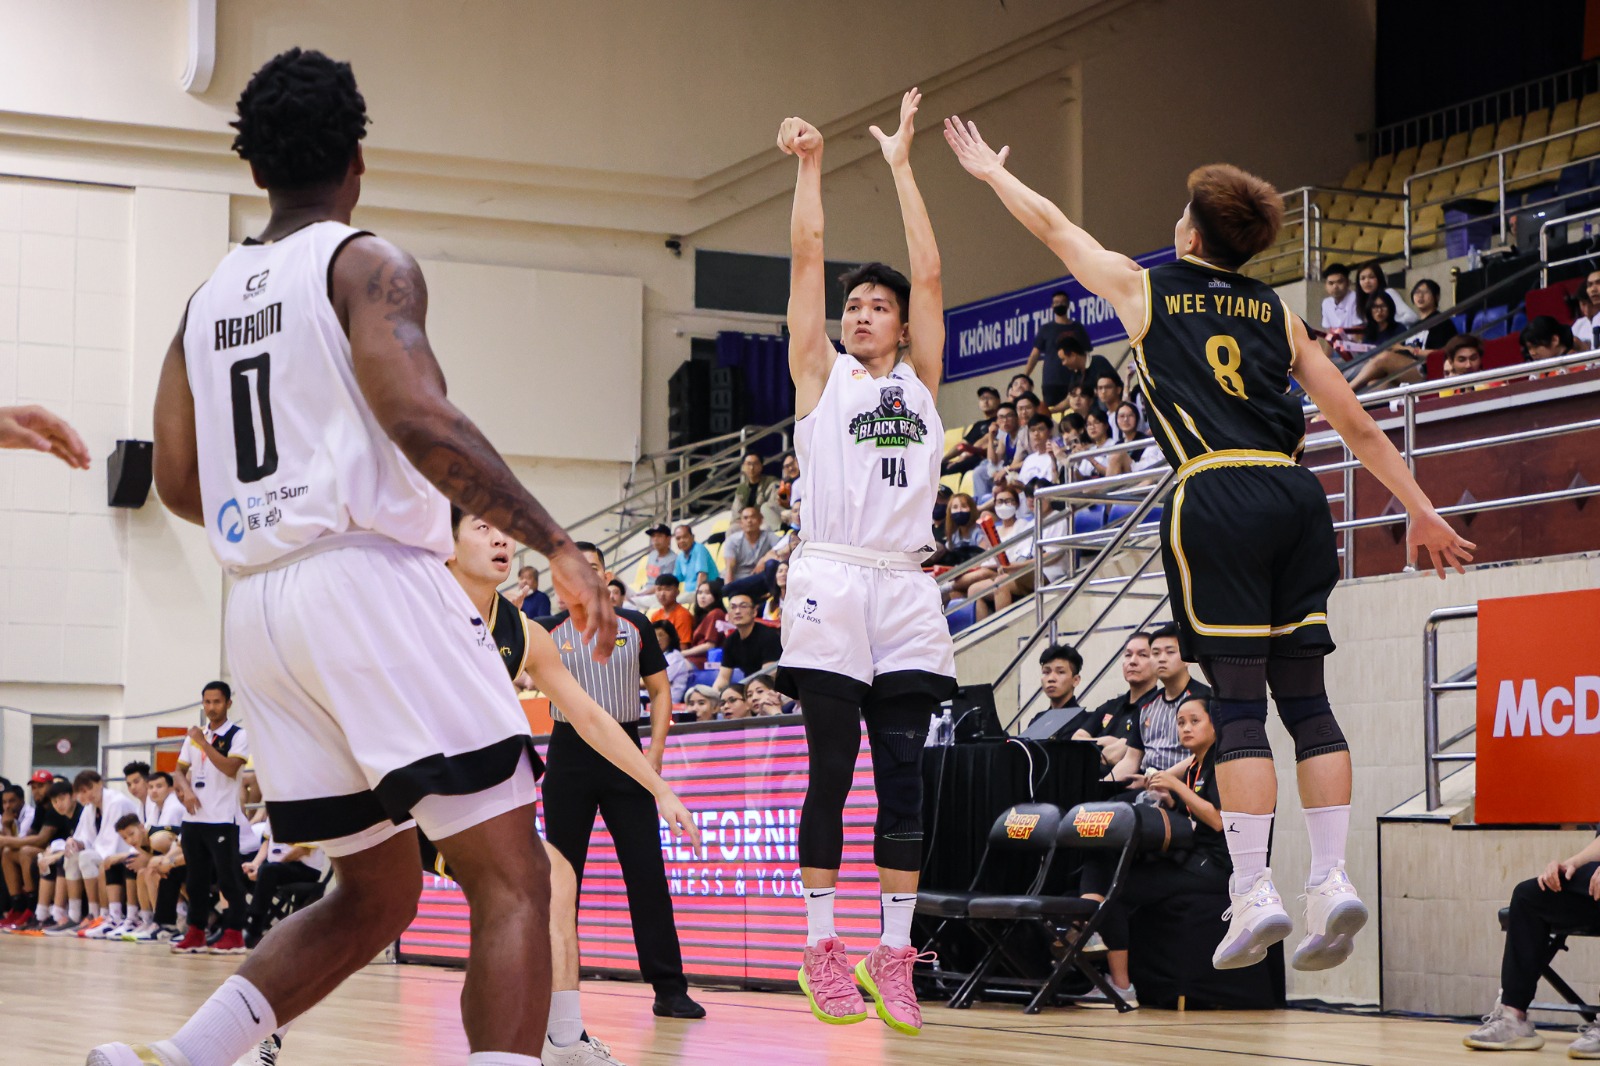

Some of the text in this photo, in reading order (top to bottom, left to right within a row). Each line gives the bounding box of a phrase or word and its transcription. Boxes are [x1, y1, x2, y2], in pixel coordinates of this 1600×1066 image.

[245, 269, 270, 292] C2
[1164, 293, 1272, 323] WEE YIANG
[959, 320, 1001, 357] KHÔNG
[1004, 309, 1030, 346] HÚT
[1078, 295, 1119, 325] TRON
[1205, 334, 1249, 400] 8
[230, 352, 279, 483] 0
[858, 420, 897, 440] BLACK
[280, 485, 309, 500] Sum
[1004, 813, 1040, 826] SAIGON
[1073, 811, 1114, 825] SAIGON
[660, 808, 796, 861] ALIFORNI
[1008, 826, 1035, 839] HEAT
[1077, 824, 1109, 837] HEAT
[671, 868, 804, 897] NESS & YOG
